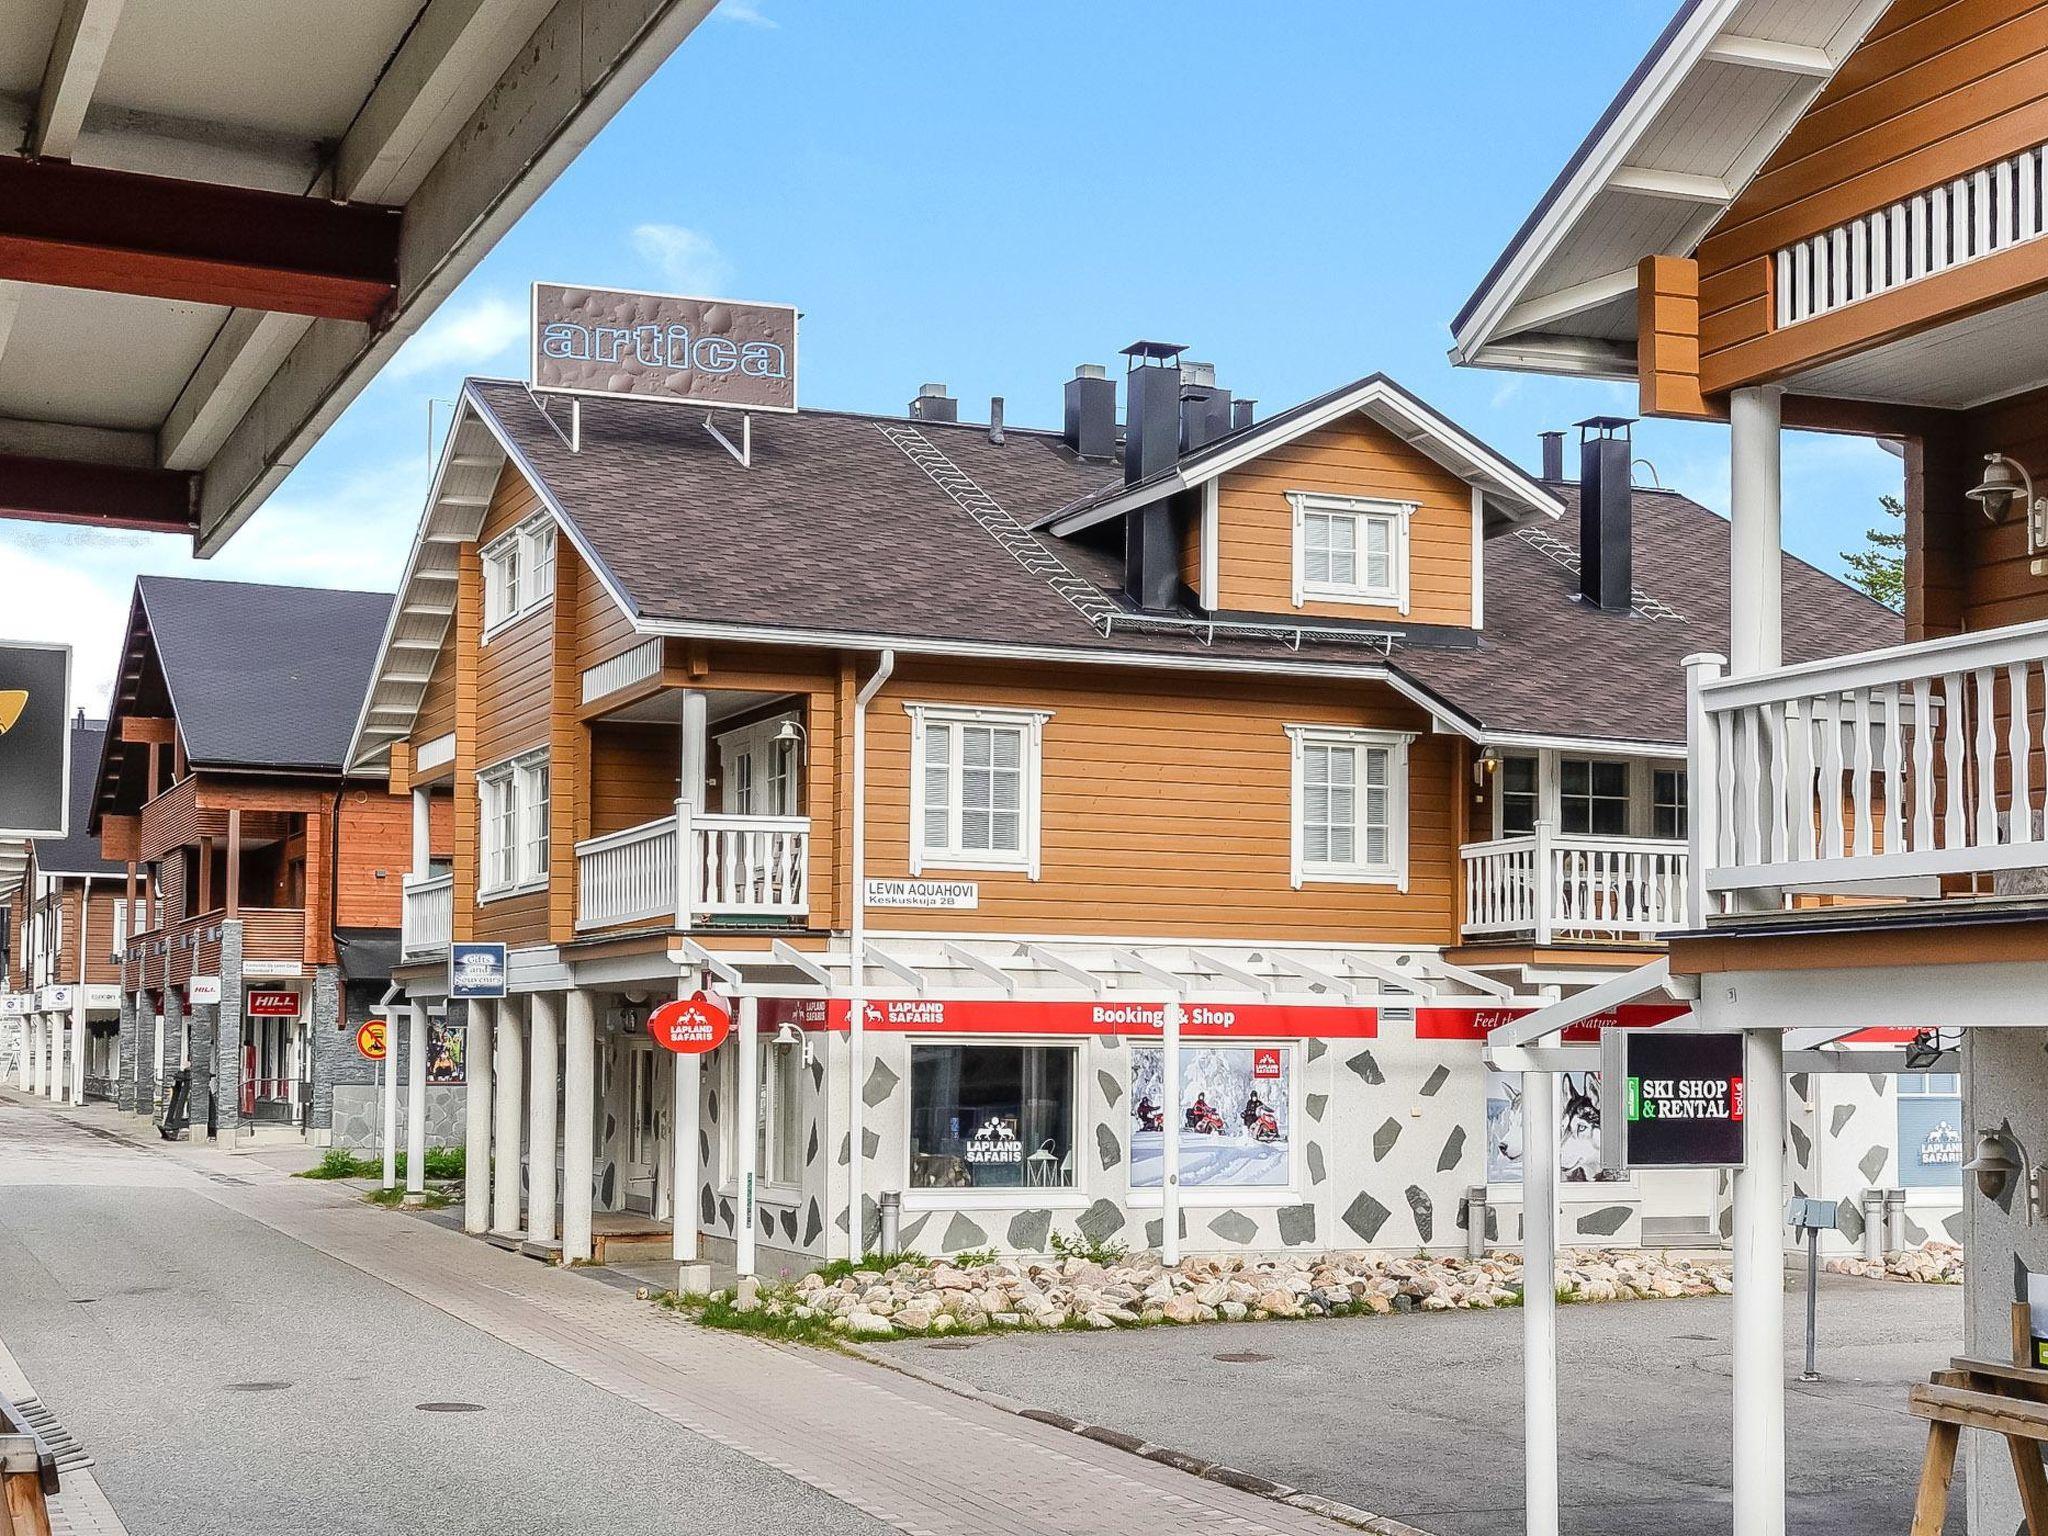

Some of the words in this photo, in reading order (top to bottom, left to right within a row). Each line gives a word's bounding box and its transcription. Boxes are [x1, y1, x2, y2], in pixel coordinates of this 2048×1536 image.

[542, 322, 787, 379] artica
[868, 882, 904, 895] LEVIN
[908, 884, 973, 898] AQUAHOVI
[868, 896, 936, 906] Keskuskuja
[254, 996, 295, 1006] HILL
[888, 1002, 944, 1013] LAPLAND
[888, 1013, 944, 1023] SAFARIS
[1092, 1006, 1165, 1028] Booking
[1192, 1008, 1236, 1028] Shop
[1473, 1012, 1499, 1028] Feel
[670, 1025, 713, 1034] LAPLAND
[670, 1033, 713, 1042] SAFARIS
[1643, 1080, 1674, 1098] SKI
[1679, 1080, 1728, 1098] SHOP
[1642, 1100, 1656, 1118] &
[1658, 1100, 1730, 1118] RENTAL
[966, 1141, 1022, 1151] LAPLAND
[965, 1152, 1022, 1162] SAFARIS
